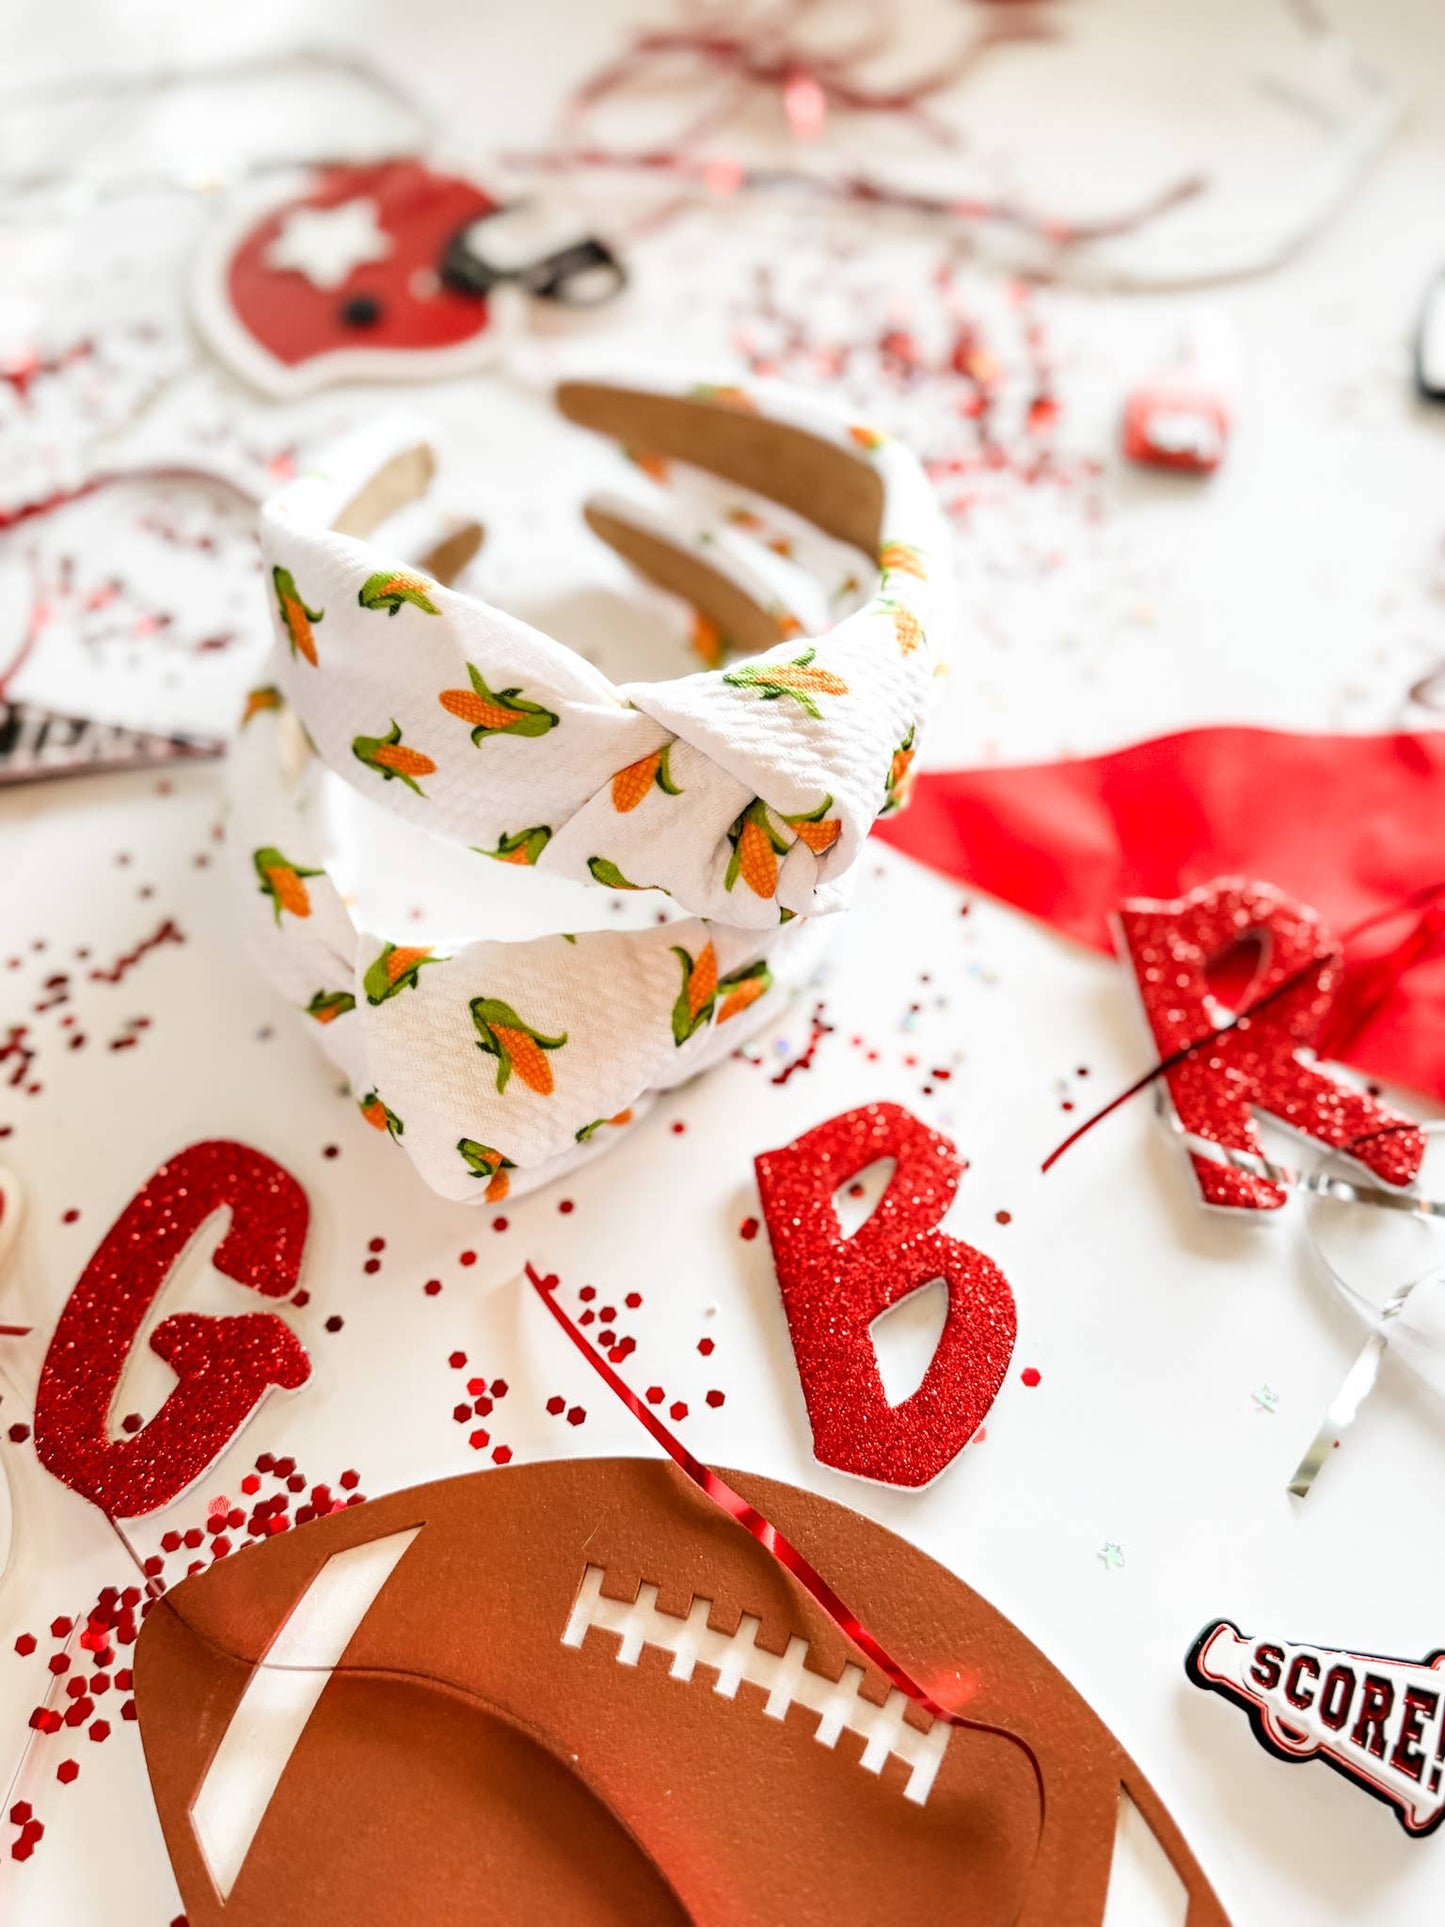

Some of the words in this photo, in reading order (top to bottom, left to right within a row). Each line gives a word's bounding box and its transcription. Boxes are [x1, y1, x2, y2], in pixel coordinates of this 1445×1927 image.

[1114, 876, 1427, 1211] R
[34, 1139, 313, 1518] G
[755, 1101, 1018, 1489] B
